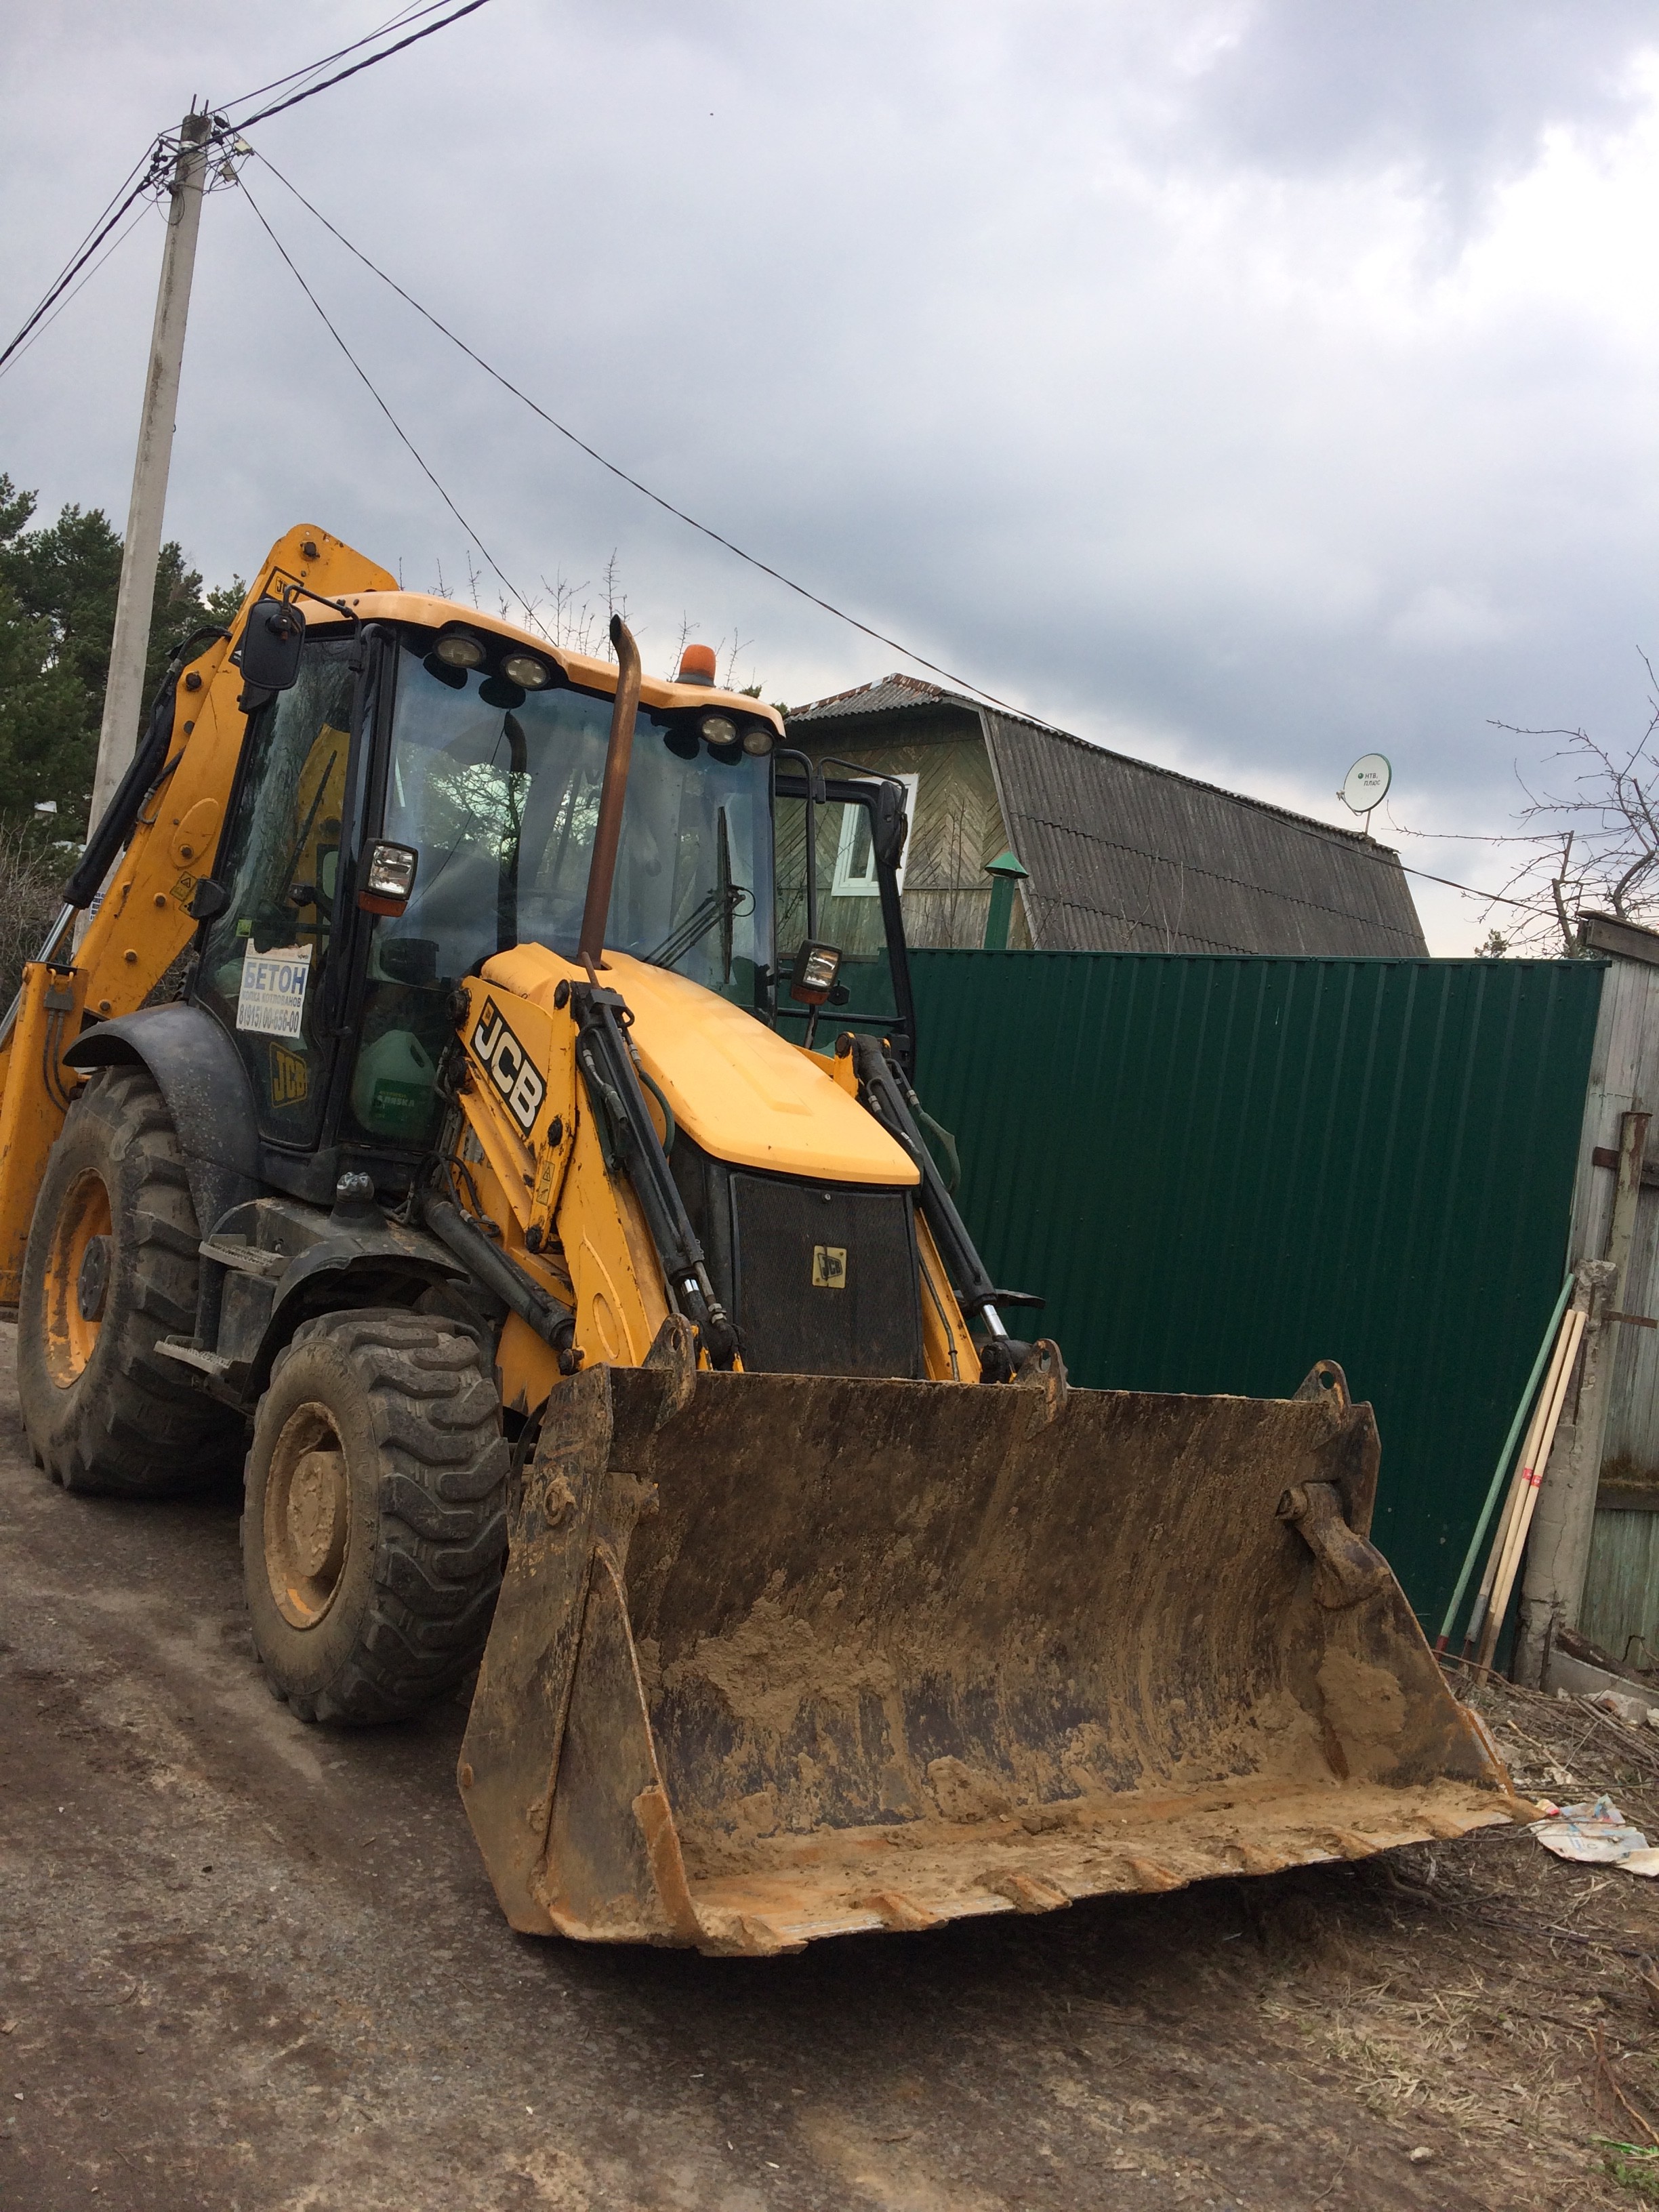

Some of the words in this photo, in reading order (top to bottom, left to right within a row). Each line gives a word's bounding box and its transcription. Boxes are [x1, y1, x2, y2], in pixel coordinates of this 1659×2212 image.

[244, 962, 306, 995] БЕТОН
[242, 991, 260, 1002] КОПКА
[262, 993, 301, 1008] КОТЛОВАНОВ
[273, 1050, 306, 1102] JCB
[474, 1017, 542, 1128] JCB
[821, 1255, 841, 1277] JCB
